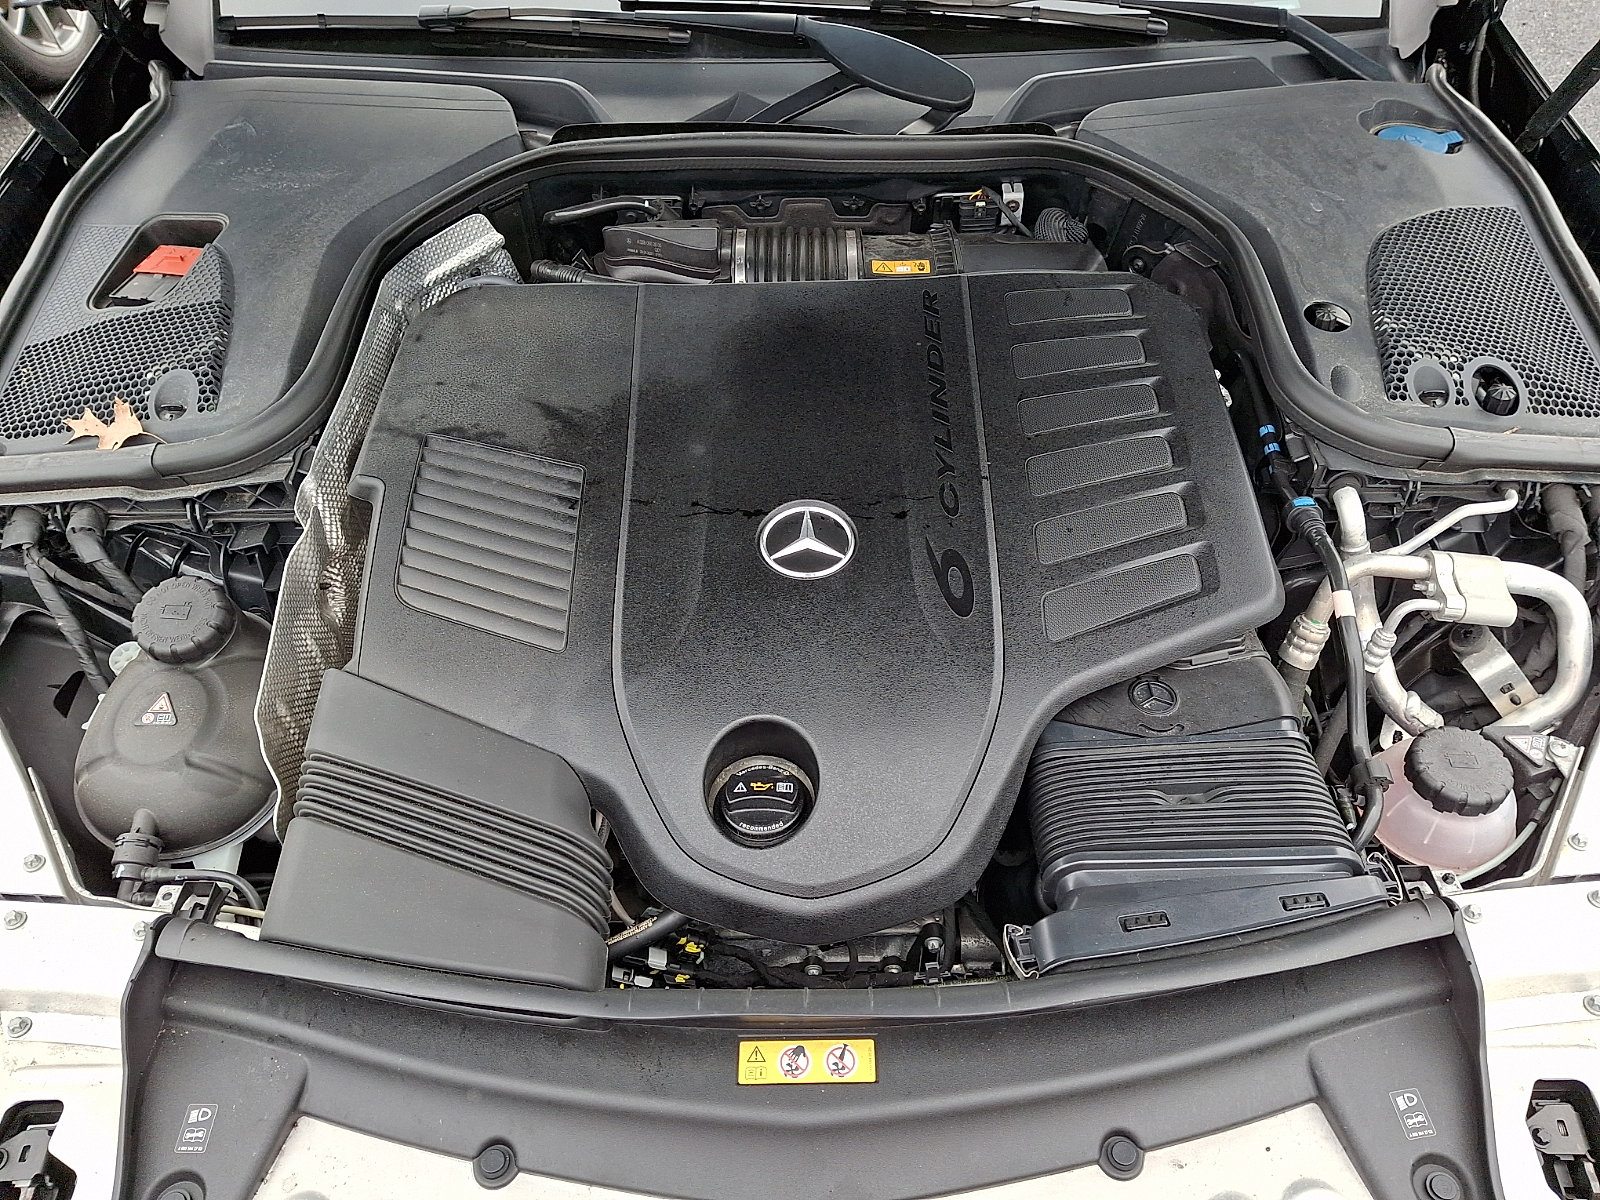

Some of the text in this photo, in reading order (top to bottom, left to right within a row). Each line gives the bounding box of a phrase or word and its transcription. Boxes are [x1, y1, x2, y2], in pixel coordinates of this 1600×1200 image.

[922, 288, 976, 619] 6 CYLINDER
[736, 764, 783, 776] Mercedes-Benz
[739, 820, 784, 832] recommended
